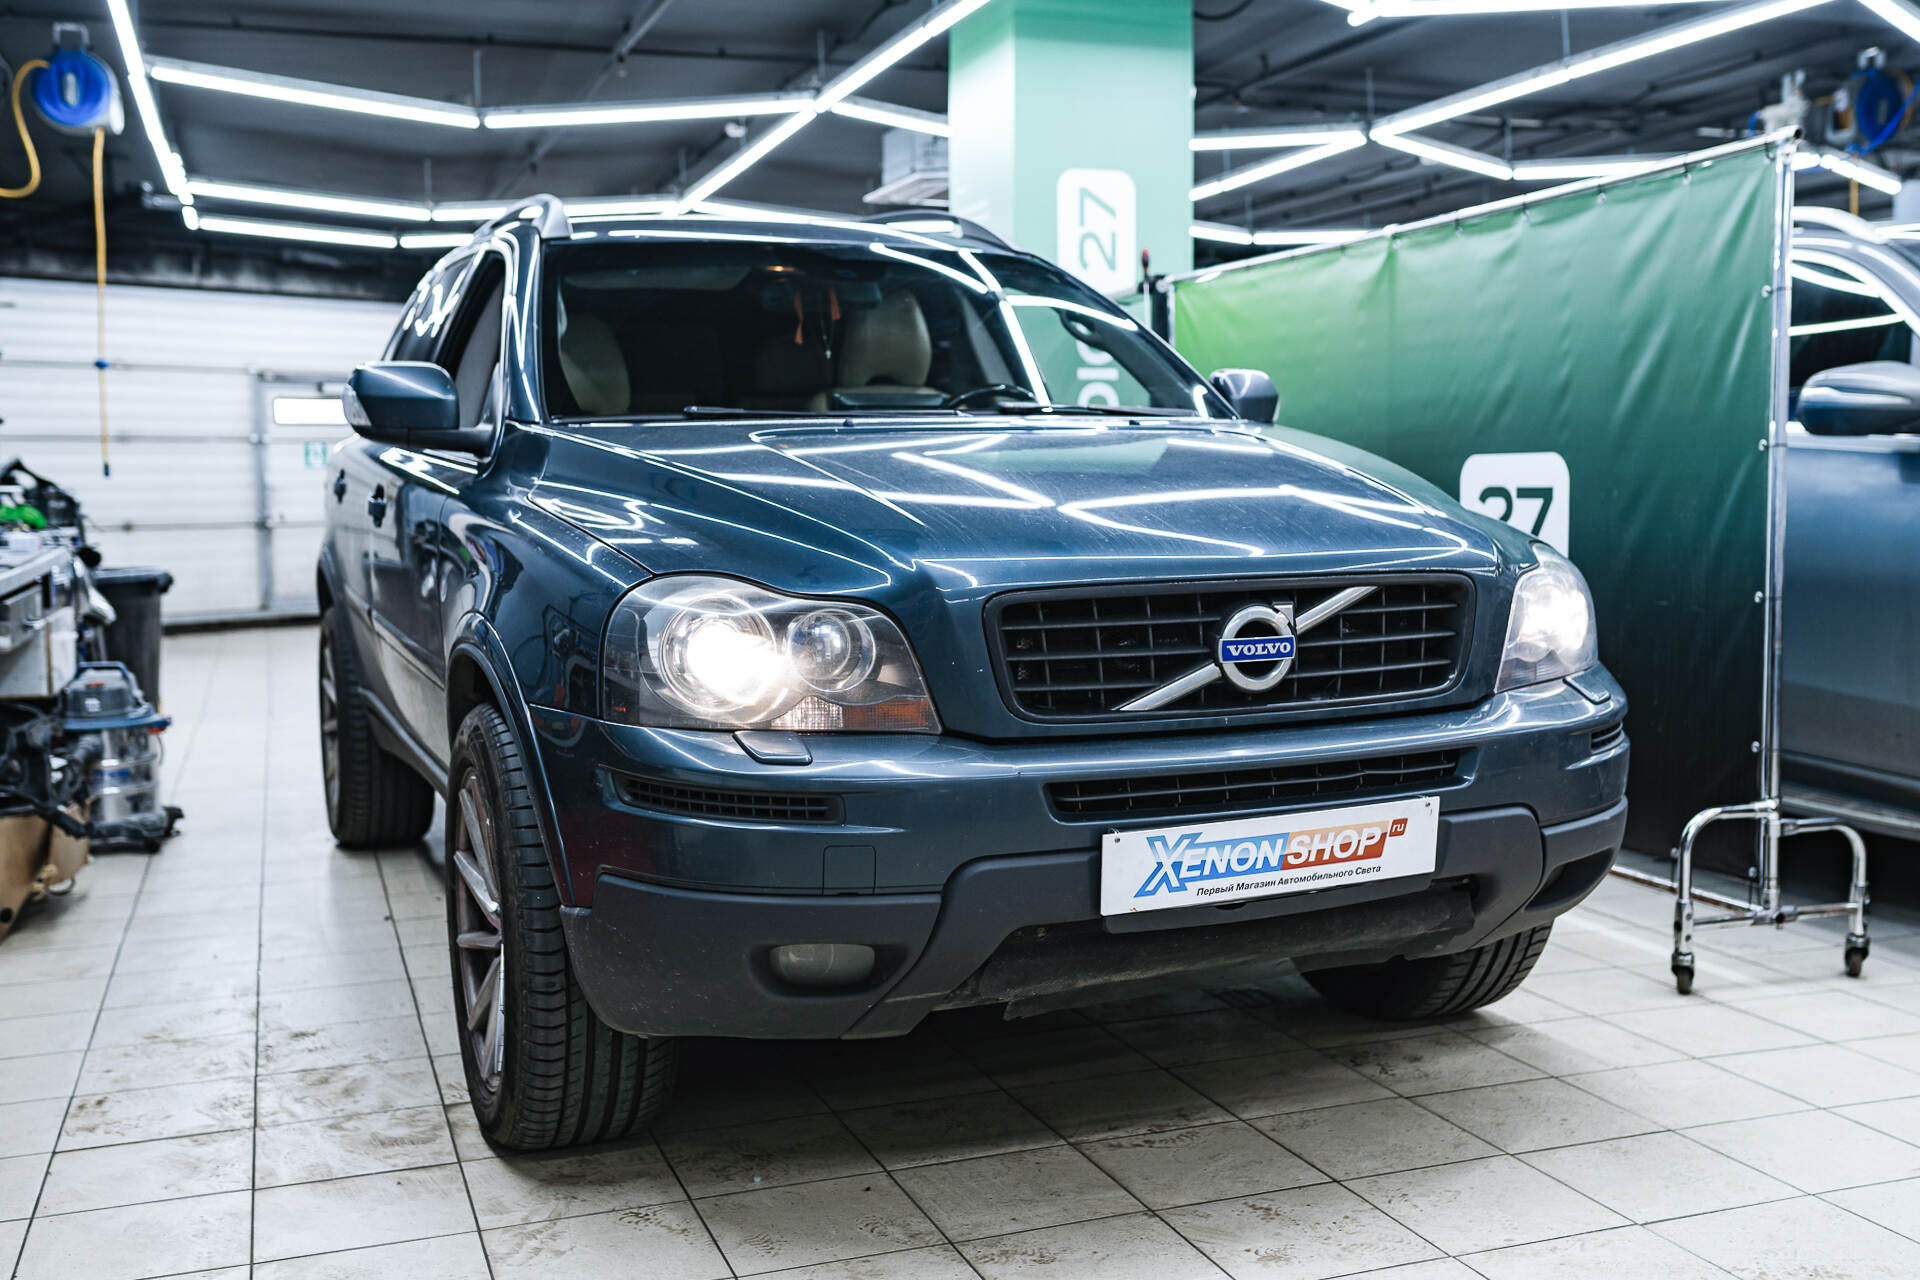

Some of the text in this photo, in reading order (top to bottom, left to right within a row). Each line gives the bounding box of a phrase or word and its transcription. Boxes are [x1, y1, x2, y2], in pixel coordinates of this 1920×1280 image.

[1078, 186, 1117, 272] 27
[1479, 486, 1554, 537] 27
[1226, 642, 1291, 656] VOLVO
[1196, 865, 1381, 897] Первый Магазин Автомобильного Света
